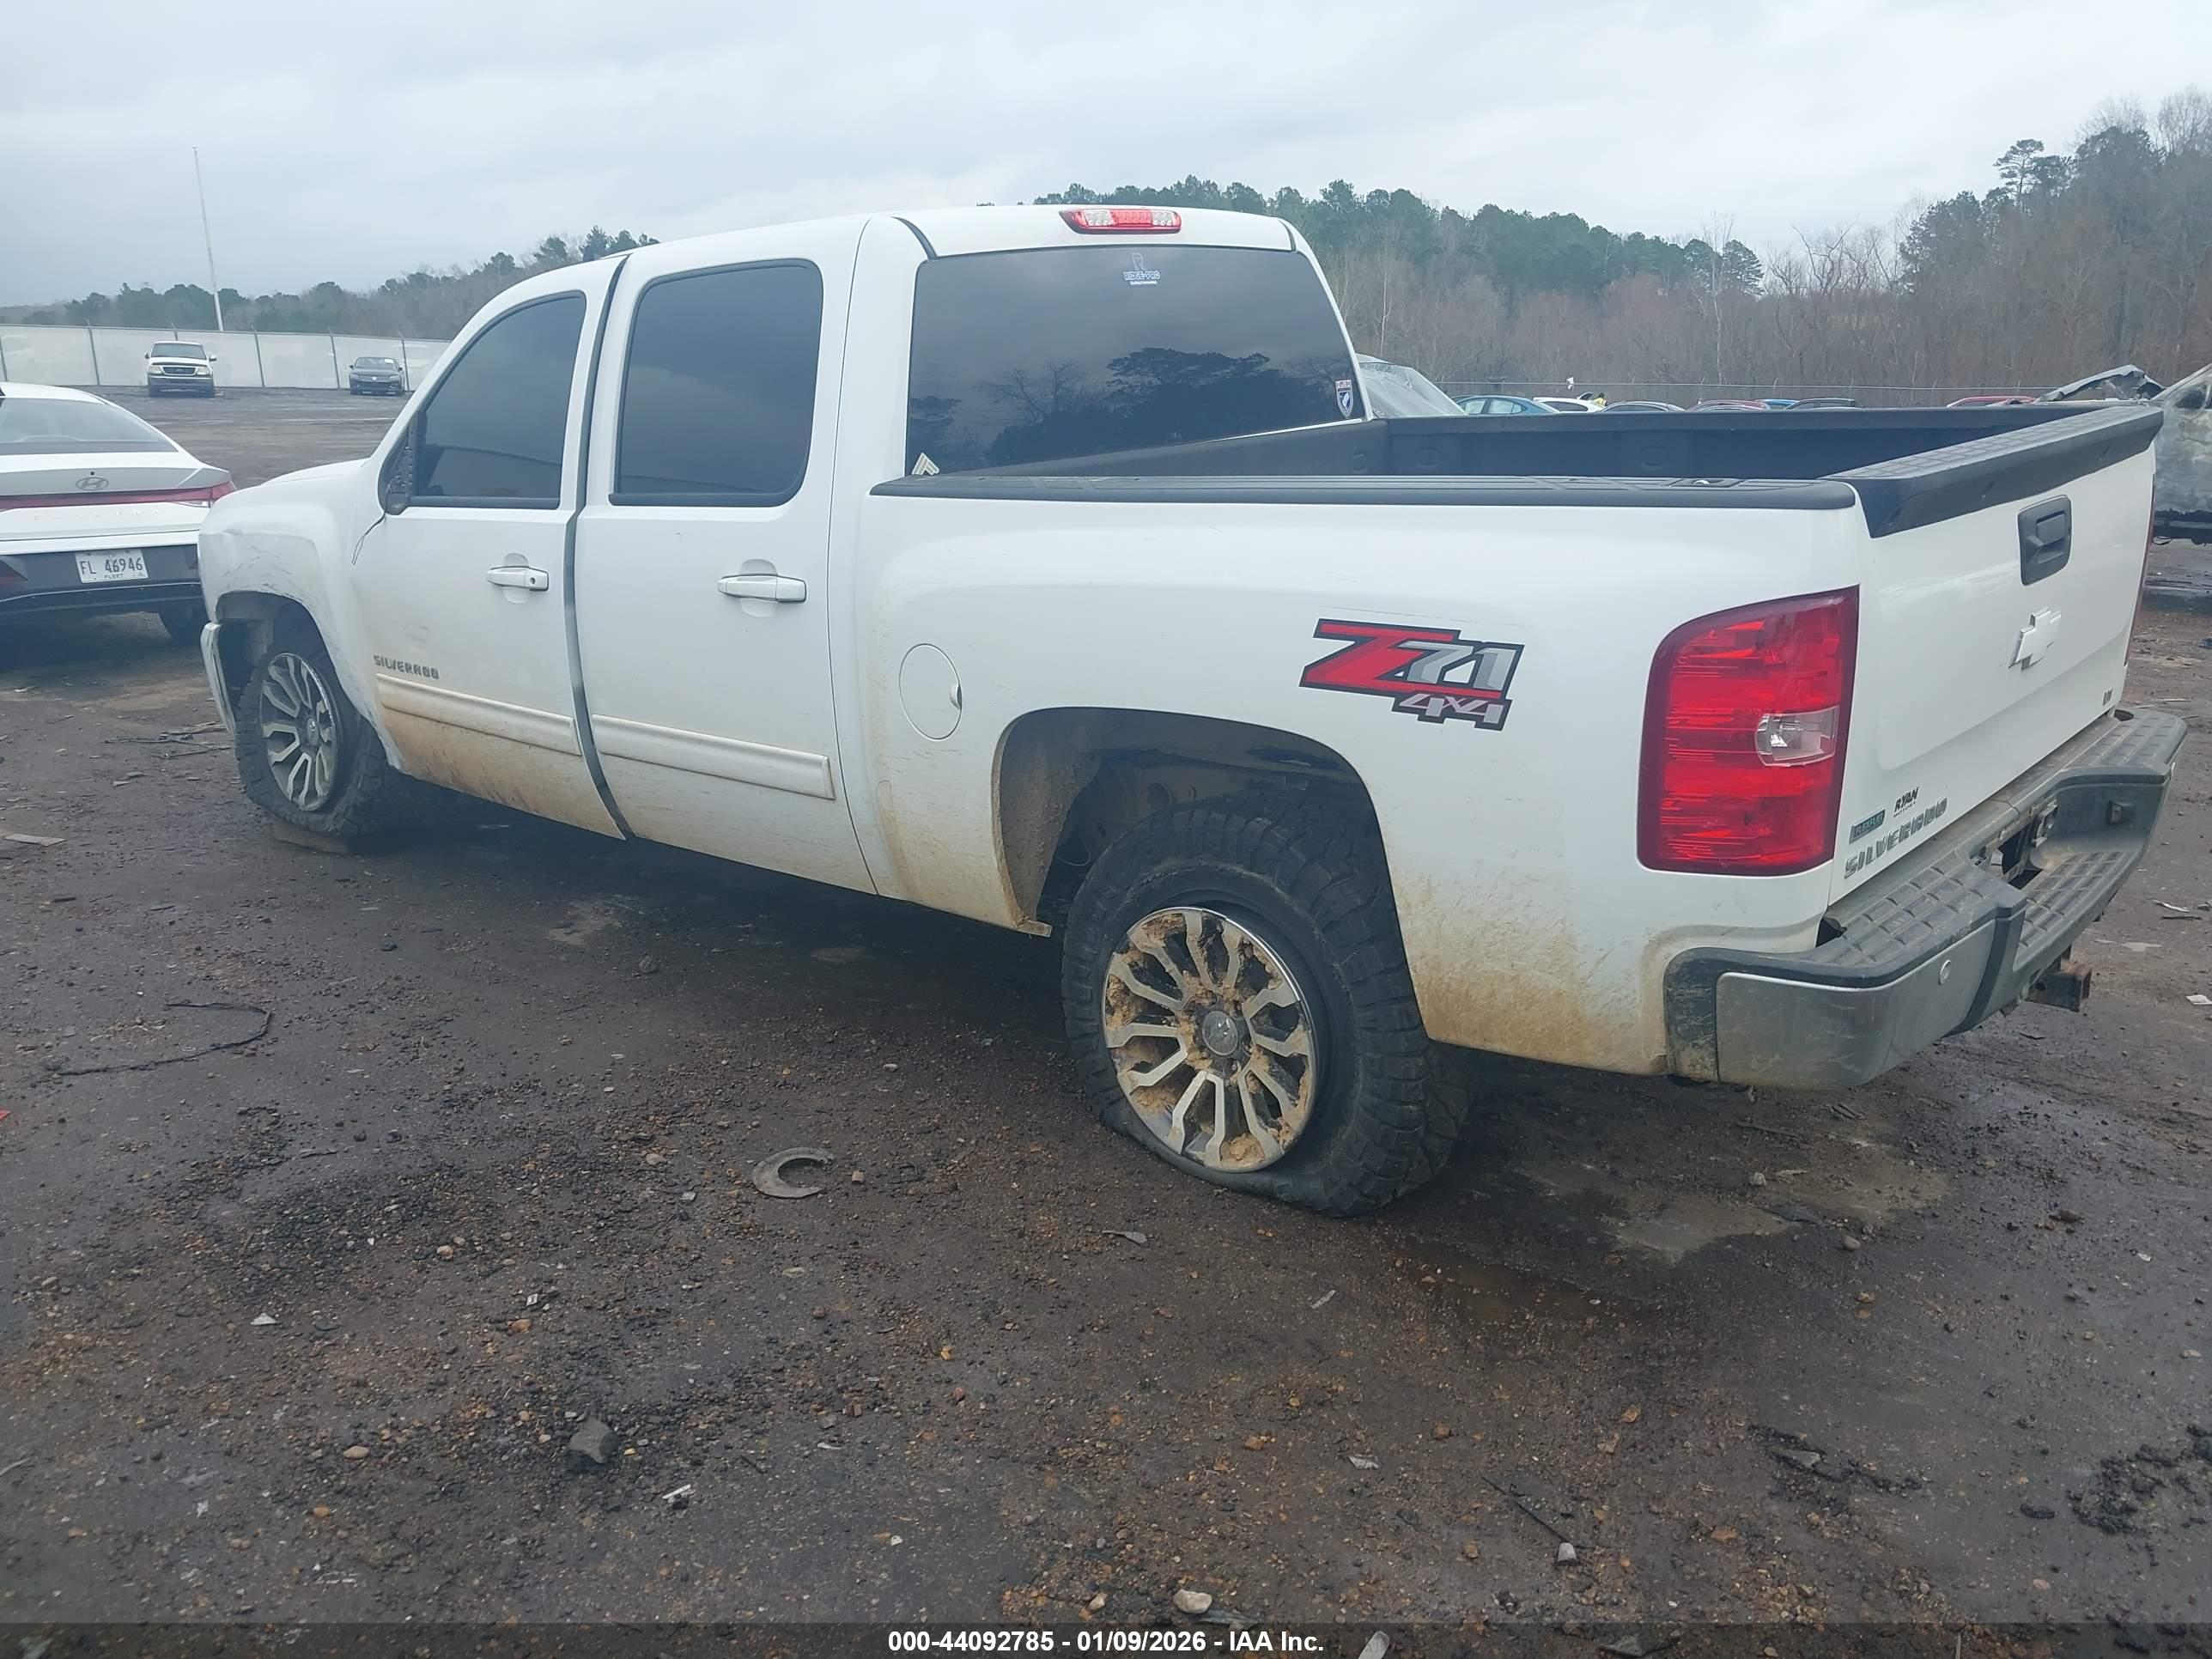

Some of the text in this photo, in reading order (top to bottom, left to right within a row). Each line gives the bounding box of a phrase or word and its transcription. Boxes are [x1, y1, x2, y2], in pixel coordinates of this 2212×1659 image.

[80, 557, 143, 575] FL 46946
[374, 655, 439, 679] SILVERADO
[1298, 617, 1525, 702] Z71
[1893, 787, 1919, 812] RYAN
[1844, 796, 1948, 879] SILVERADO
